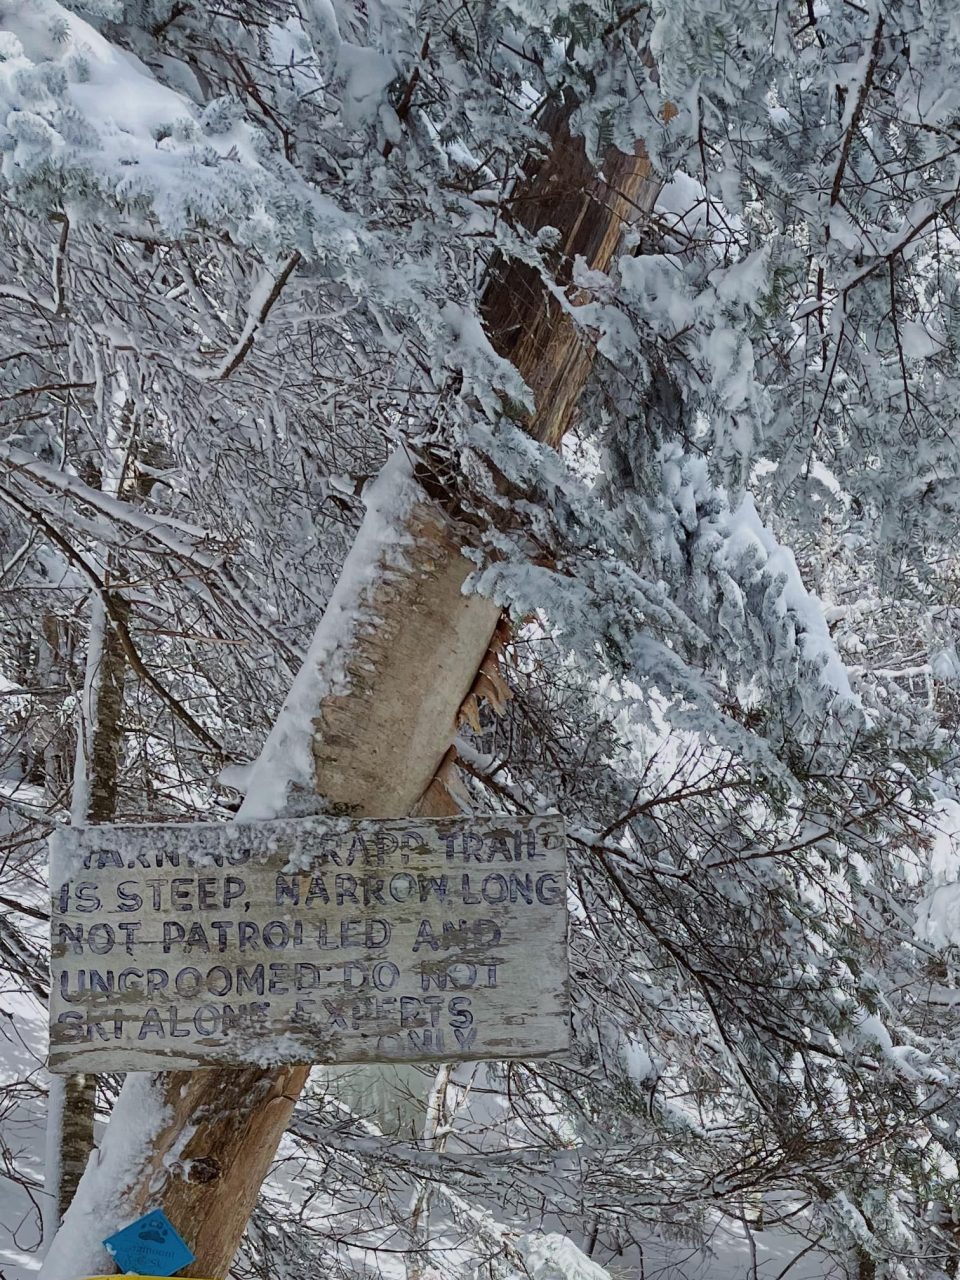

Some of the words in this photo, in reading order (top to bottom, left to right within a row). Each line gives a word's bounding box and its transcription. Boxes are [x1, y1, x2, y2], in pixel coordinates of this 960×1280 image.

[438, 827, 546, 863] TRAIL
[58, 879, 102, 914] IS
[108, 875, 252, 914] STEEP,
[461, 871, 562, 906] LONG
[59, 920, 142, 956] NOT
[162, 918, 392, 954] PATROLLED
[411, 918, 503, 953] AND
[343, 960, 401, 993] DO
[420, 961, 499, 992] NOT
[57, 1006, 124, 1043] SKI
[376, 1024, 478, 1054] ONLY
